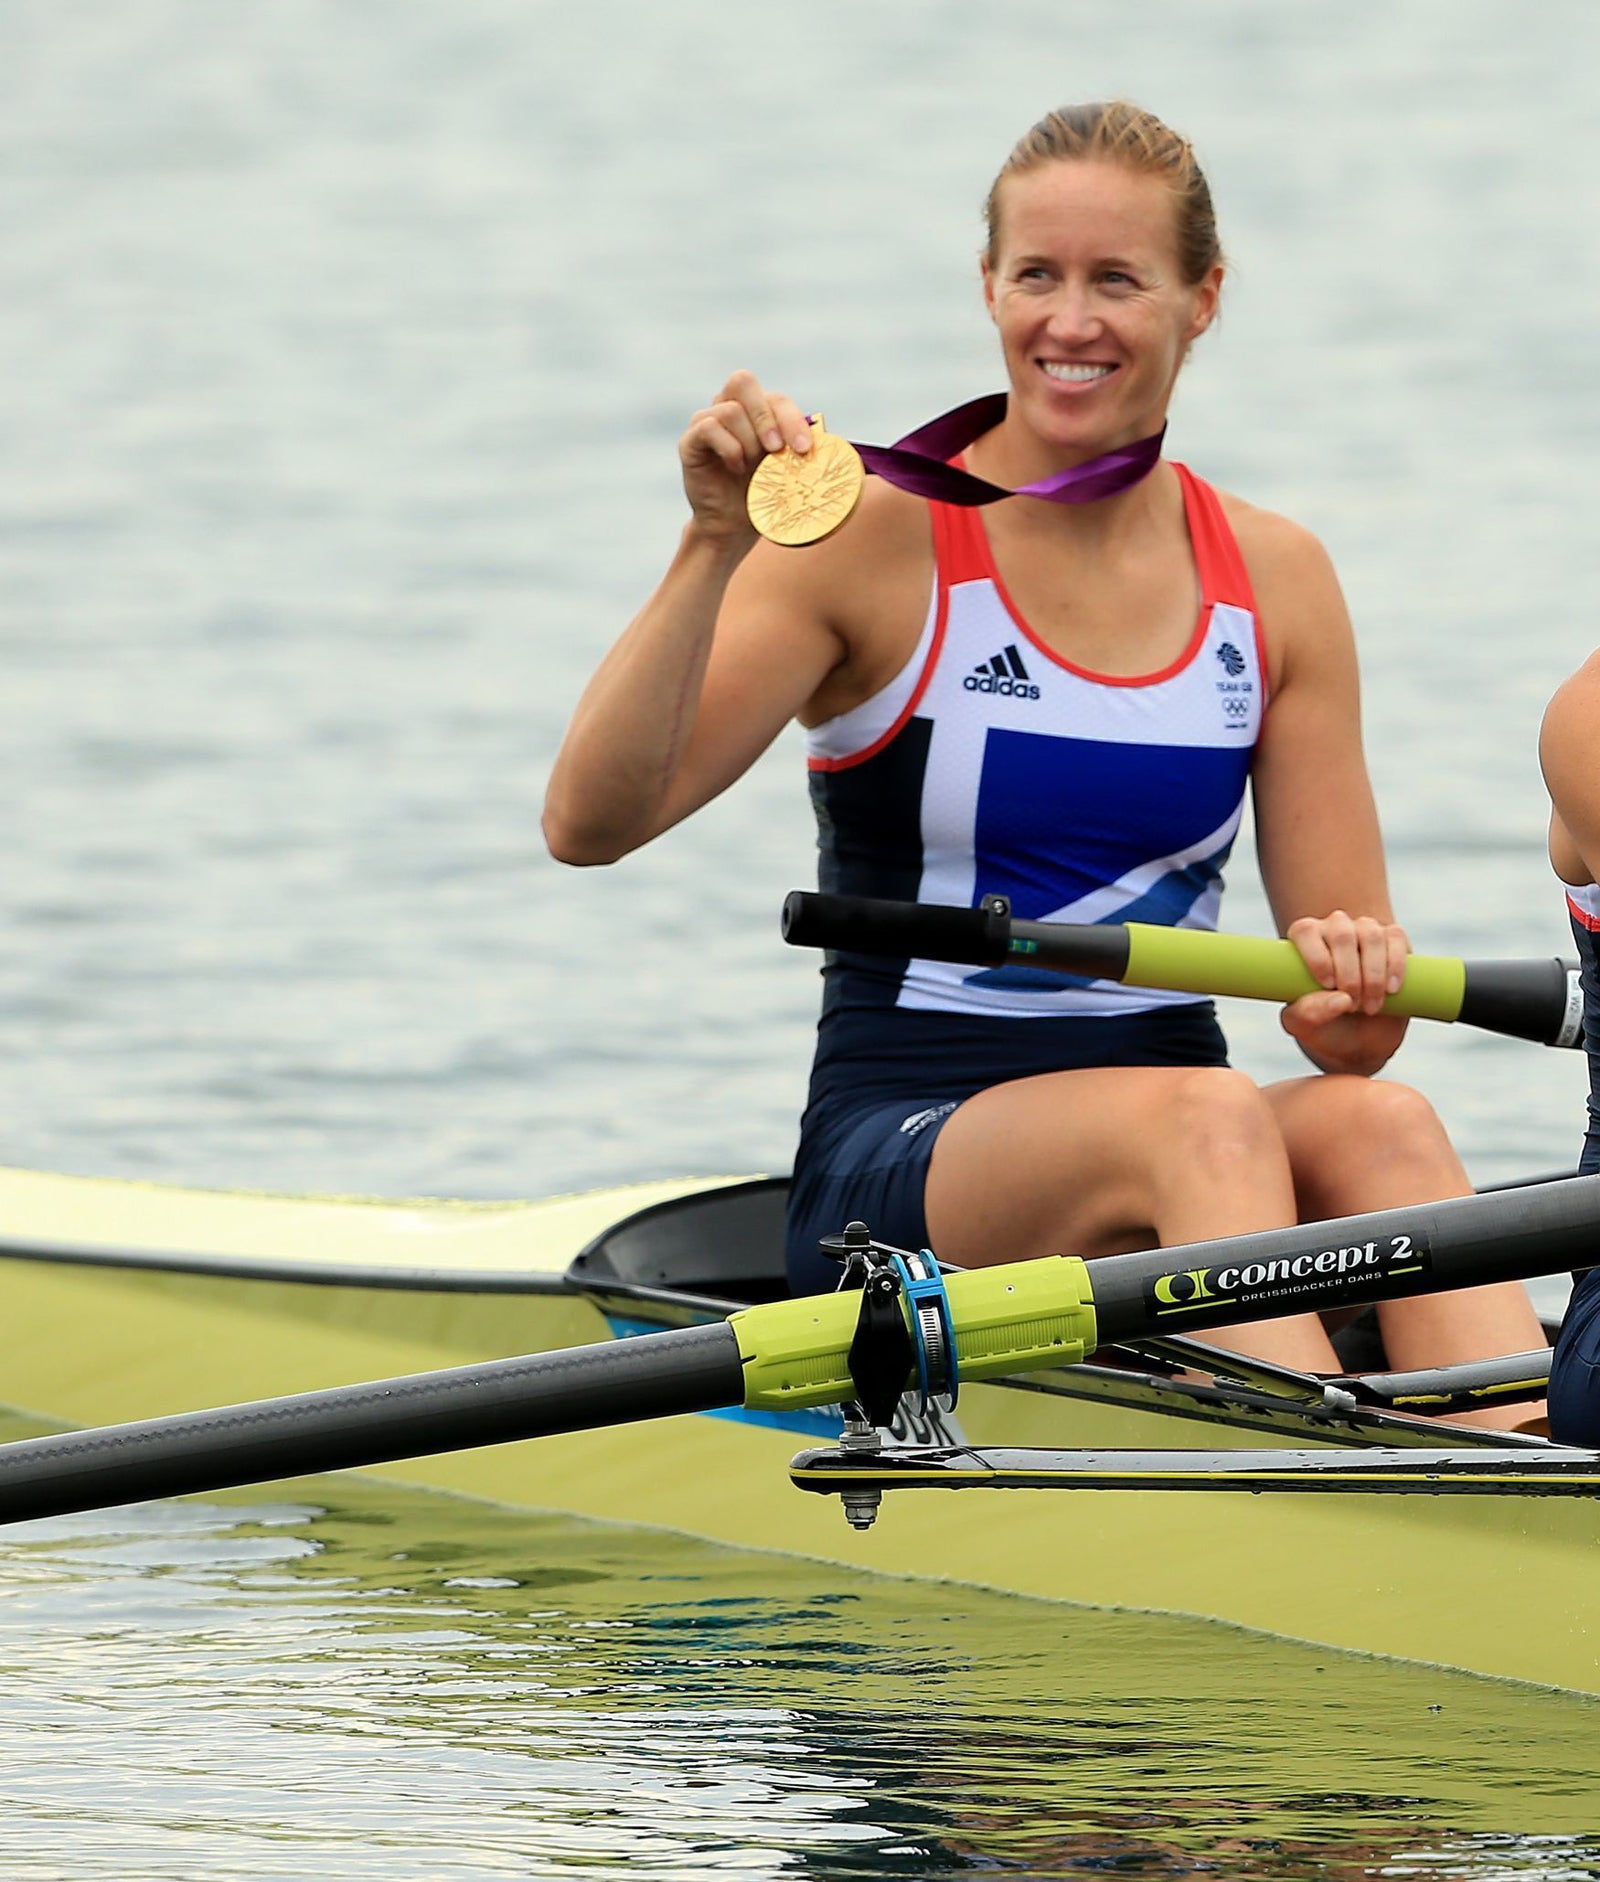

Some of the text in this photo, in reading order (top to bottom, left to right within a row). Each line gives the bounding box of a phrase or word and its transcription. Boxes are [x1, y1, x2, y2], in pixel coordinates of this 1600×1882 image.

[963, 674, 1041, 701] adidas
[1218, 1241, 1379, 1290] concept
[1241, 1271, 1383, 1302] DREISSIGACKER OARS
